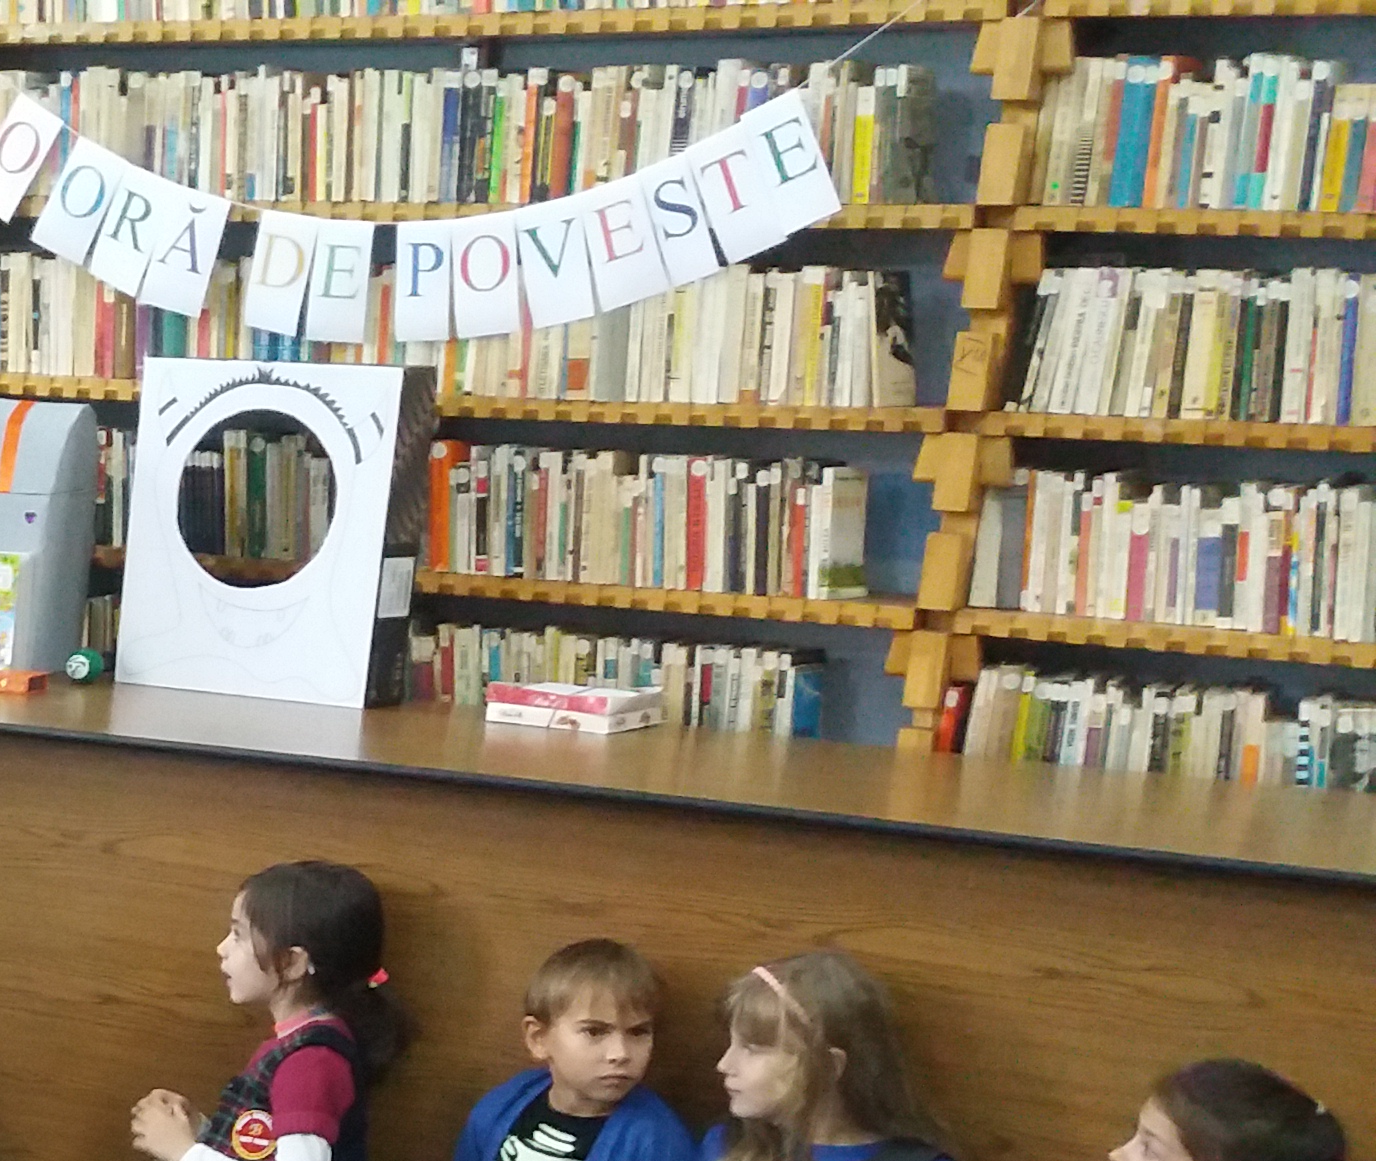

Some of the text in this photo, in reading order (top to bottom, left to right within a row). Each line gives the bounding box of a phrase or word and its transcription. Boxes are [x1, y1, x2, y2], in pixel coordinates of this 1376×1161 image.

[60, 165, 202, 275] ORĂ
[254, 233, 363, 299] DE
[407, 116, 821, 298] POVESTE
